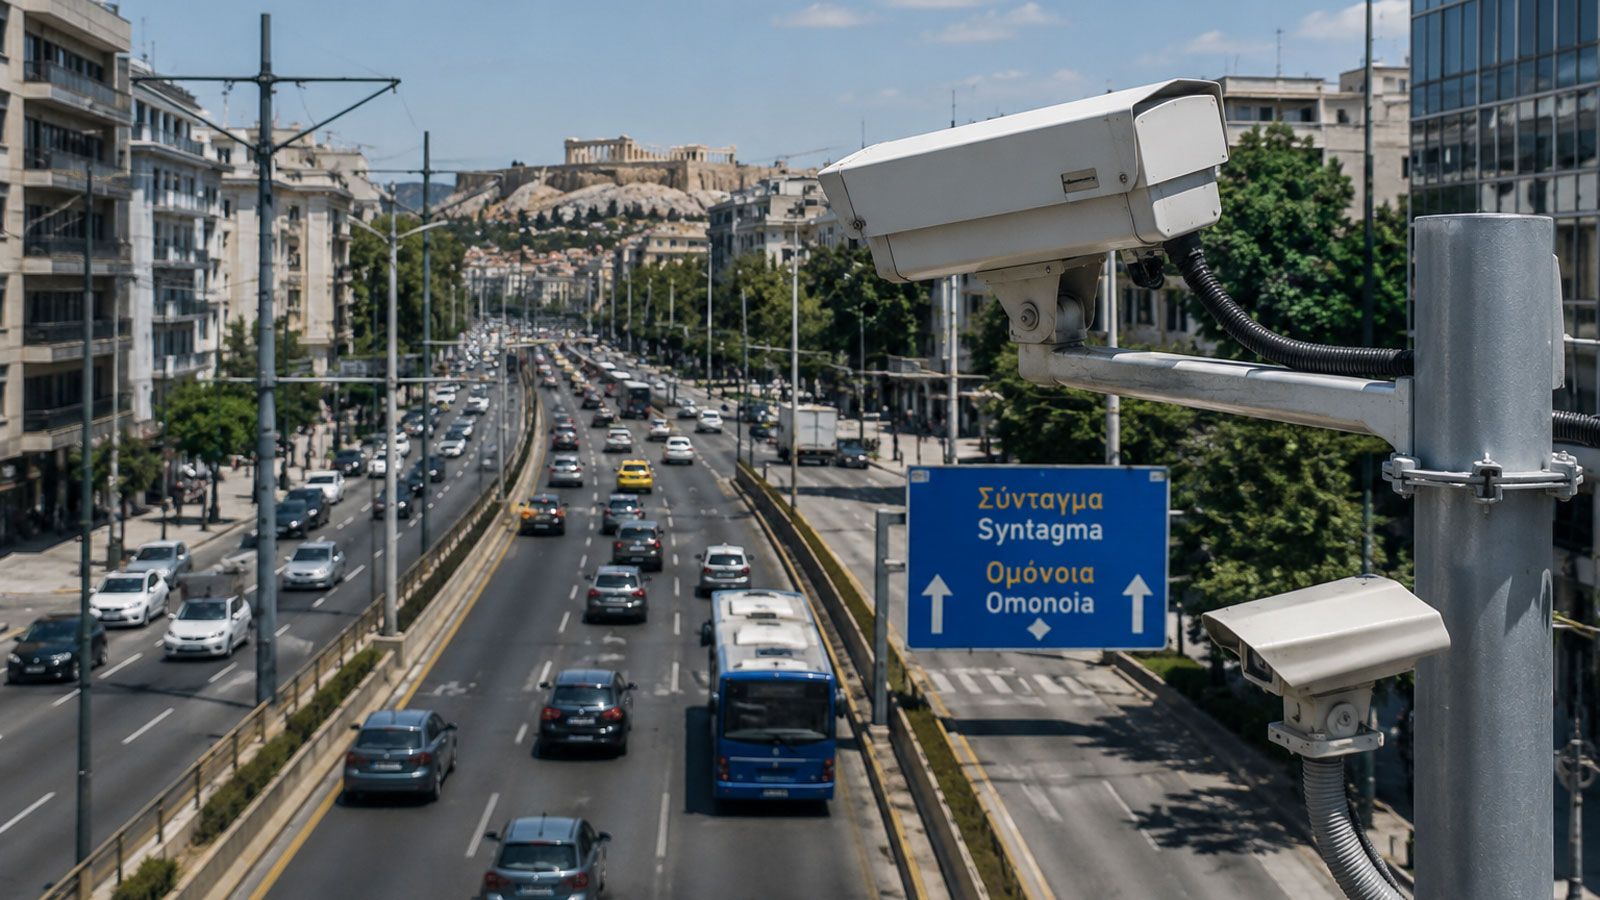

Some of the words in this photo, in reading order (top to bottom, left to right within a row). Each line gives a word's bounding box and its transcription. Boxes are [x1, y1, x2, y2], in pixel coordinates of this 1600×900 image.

[978, 486, 1103, 515] Σύνταγμα
[978, 517, 1103, 545] Syntagma
[986, 560, 1094, 589] Ομόνοια
[986, 591, 1094, 613] Omonoia
